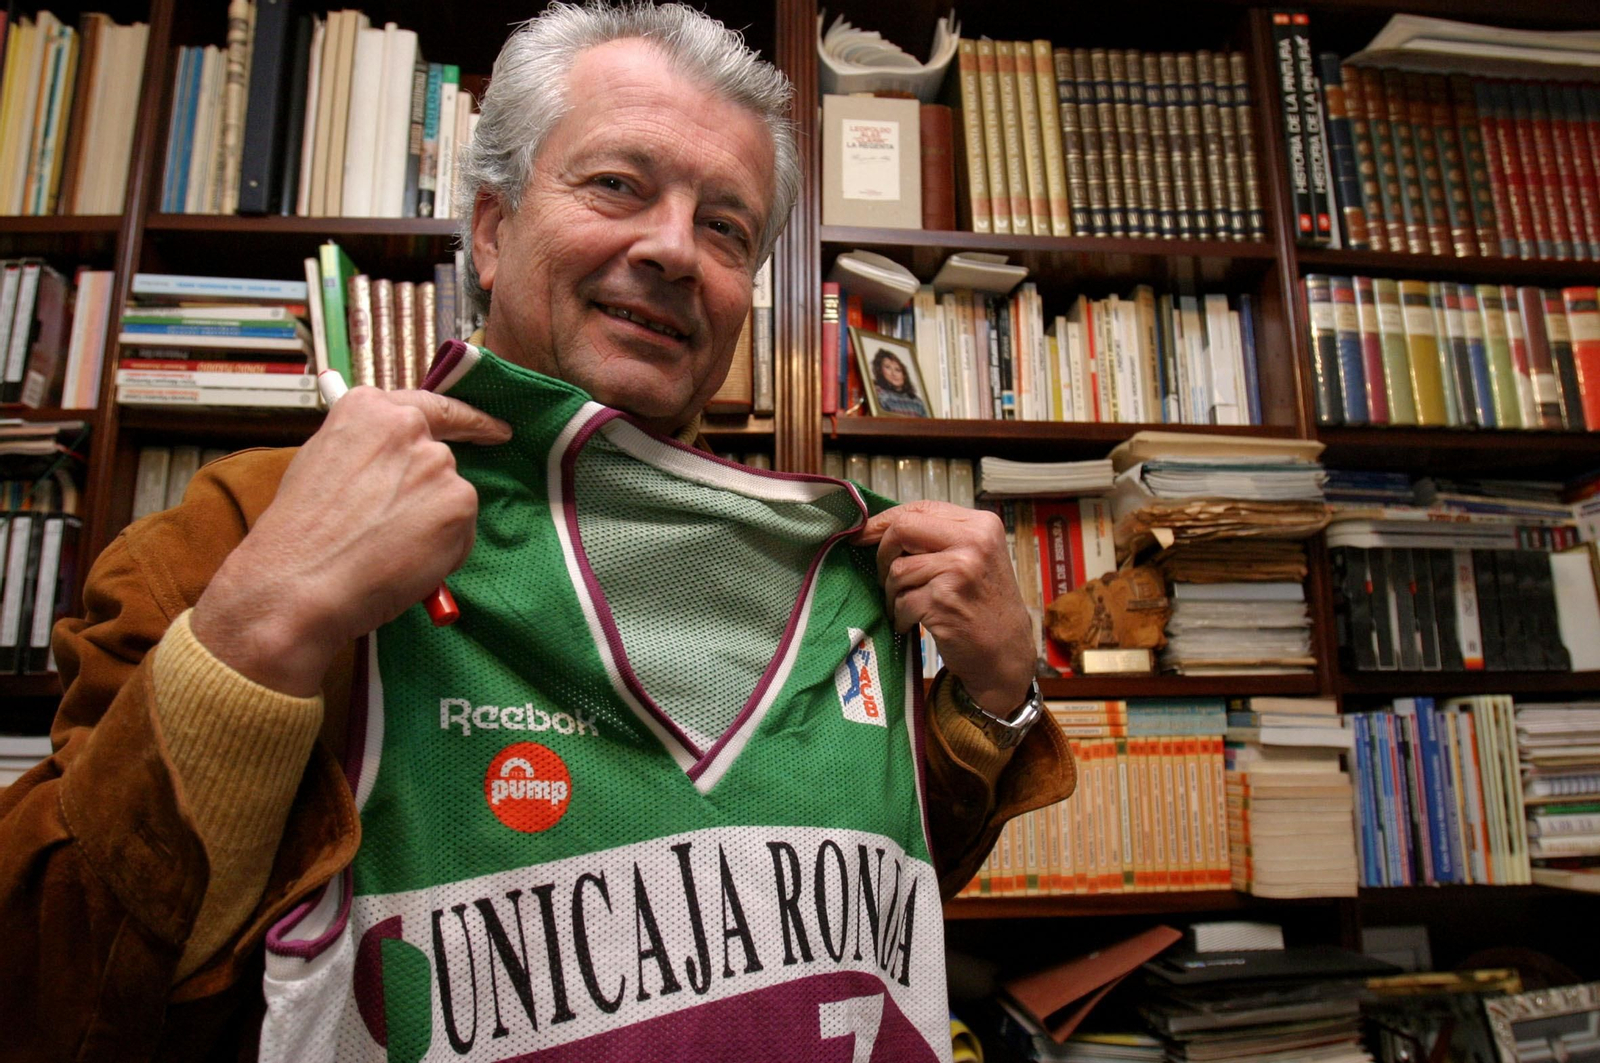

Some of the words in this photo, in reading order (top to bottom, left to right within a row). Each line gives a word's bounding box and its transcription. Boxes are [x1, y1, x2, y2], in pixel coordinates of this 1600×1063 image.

[1278, 38, 1297, 93] PINTURA
[1298, 38, 1315, 92] PINTURA
[1284, 93, 1299, 113] LA
[1302, 93, 1317, 113] LA
[970, 127, 980, 154] SANTA
[989, 127, 999, 154] SANTA
[1008, 127, 1018, 154] SANTA
[1030, 127, 1040, 155] SANTA
[1287, 114, 1301, 134] DE
[1305, 114, 1320, 134] DE
[974, 158, 984, 193] SEMANA
[992, 157, 1002, 193] SEMANA
[1010, 157, 1021, 193] SEMANA
[1032, 158, 1042, 193] SEMANA
[1289, 134, 1308, 194] HISTORIA
[1308, 134, 1326, 194] HISTORIA
[1053, 521, 1064, 561] ESPAÑA
[1057, 564, 1066, 580] DE
[858, 665, 879, 718] ACB
[439, 697, 600, 737] Reebok
[491, 779, 568, 806] pump
[431, 842, 764, 1055] UNICAJA
[765, 838, 918, 988] RONDA
[817, 991, 885, 1063] 7
